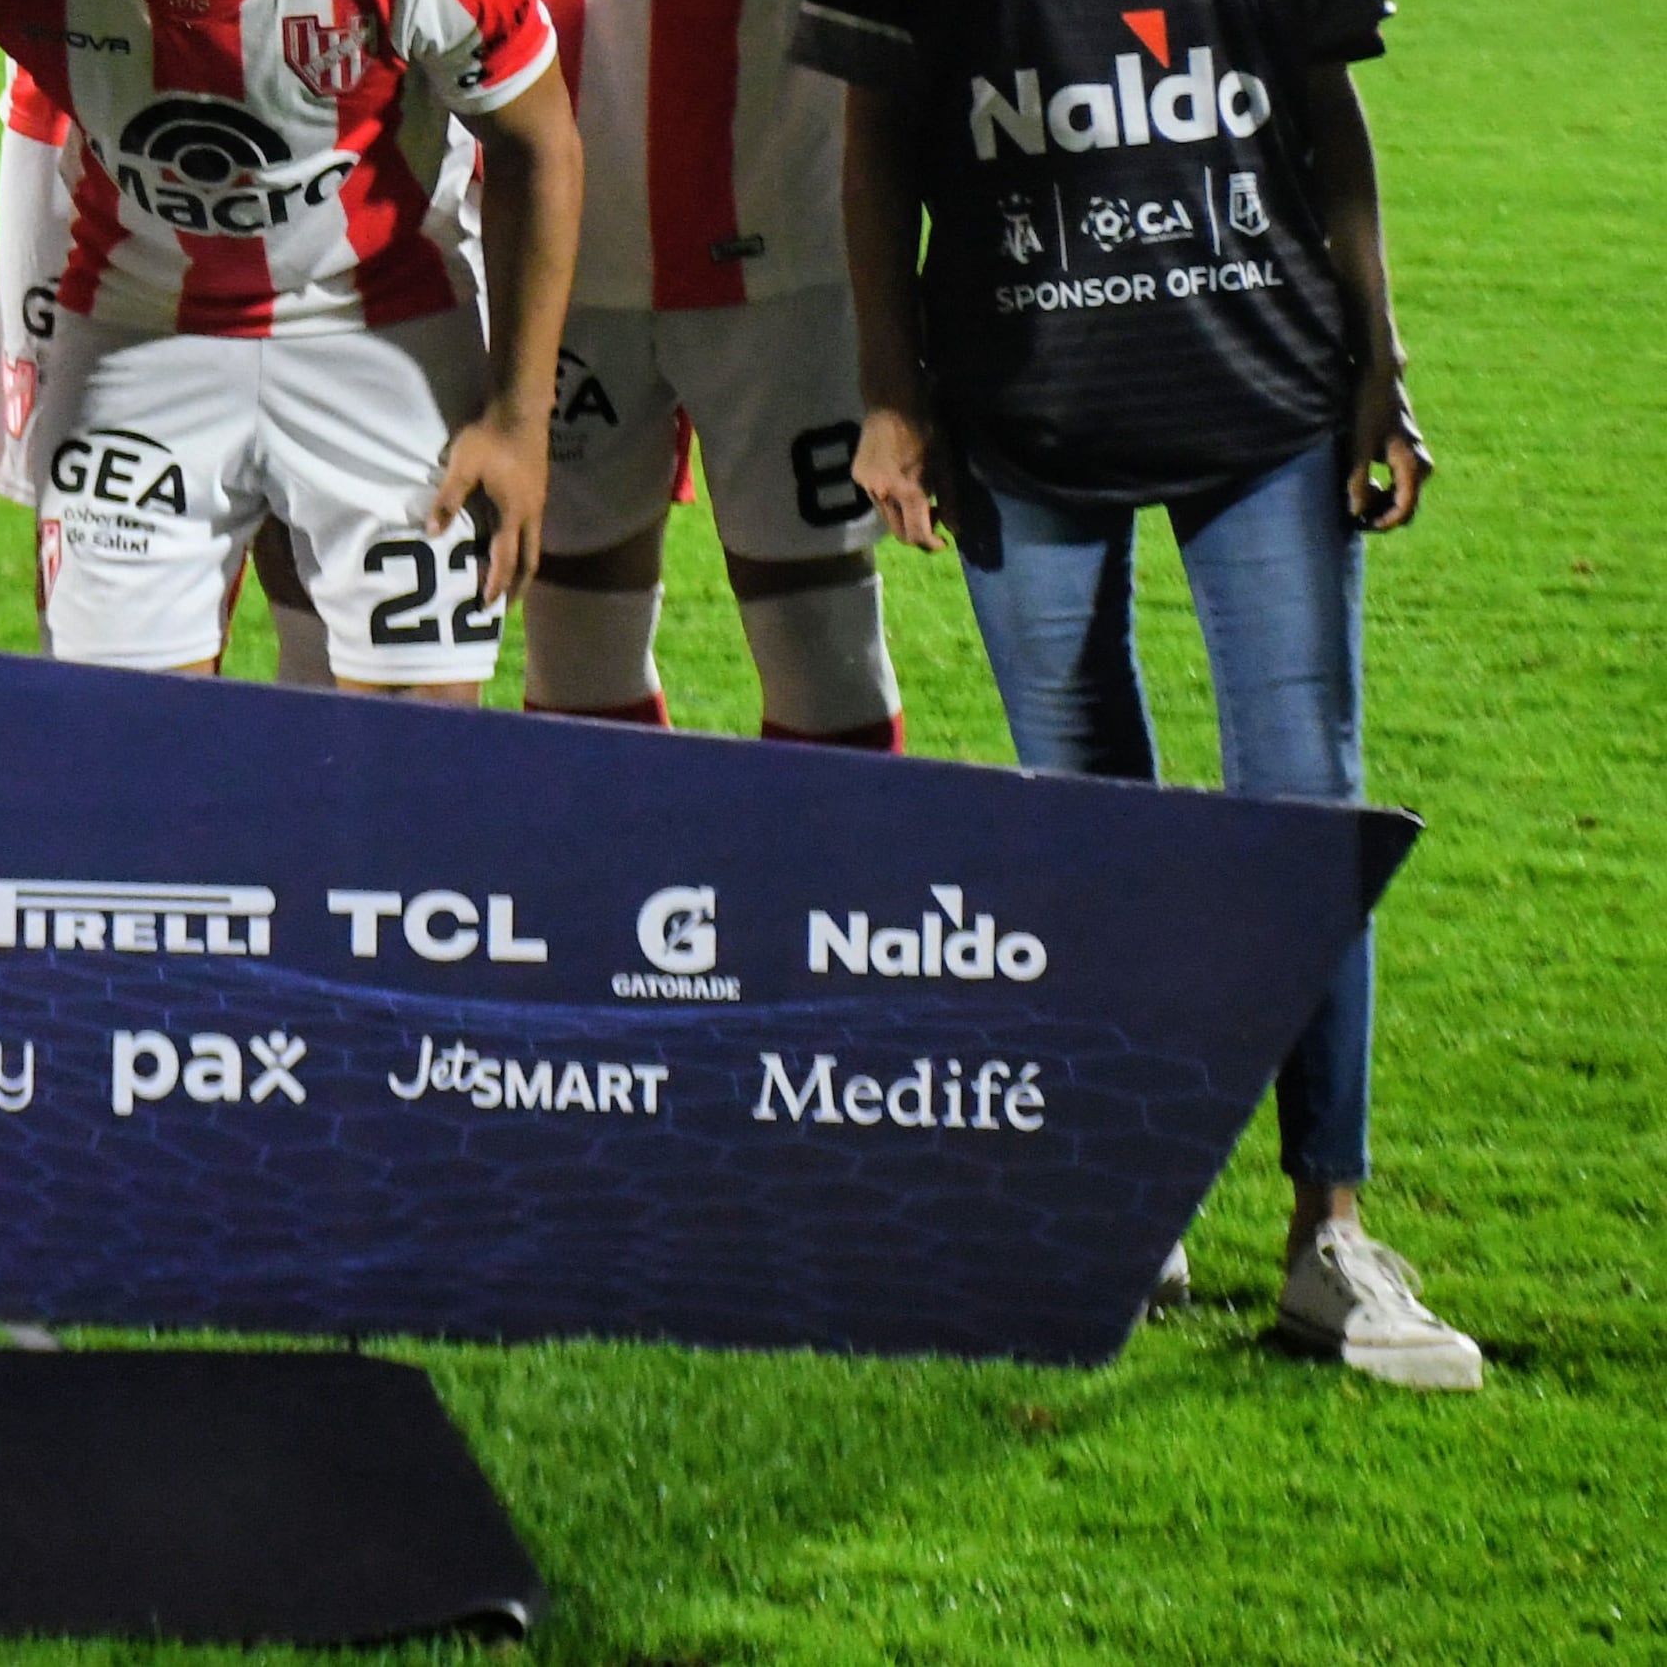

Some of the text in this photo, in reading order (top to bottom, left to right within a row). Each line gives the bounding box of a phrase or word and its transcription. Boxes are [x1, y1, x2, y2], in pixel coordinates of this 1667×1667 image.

[970, 45, 1271, 162] Naldo
[995, 260, 1283, 312] SPONSOR OFICIAL
[49, 439, 188, 517] GEA
[326, 887, 549, 964] TCL
[808, 894, 1048, 983] Naldo
[611, 971, 742, 1003] GATORADE
[111, 1029, 308, 1117] pax
[387, 1033, 670, 1115] JetSMART
[752, 1051, 1047, 1132] Medifé
